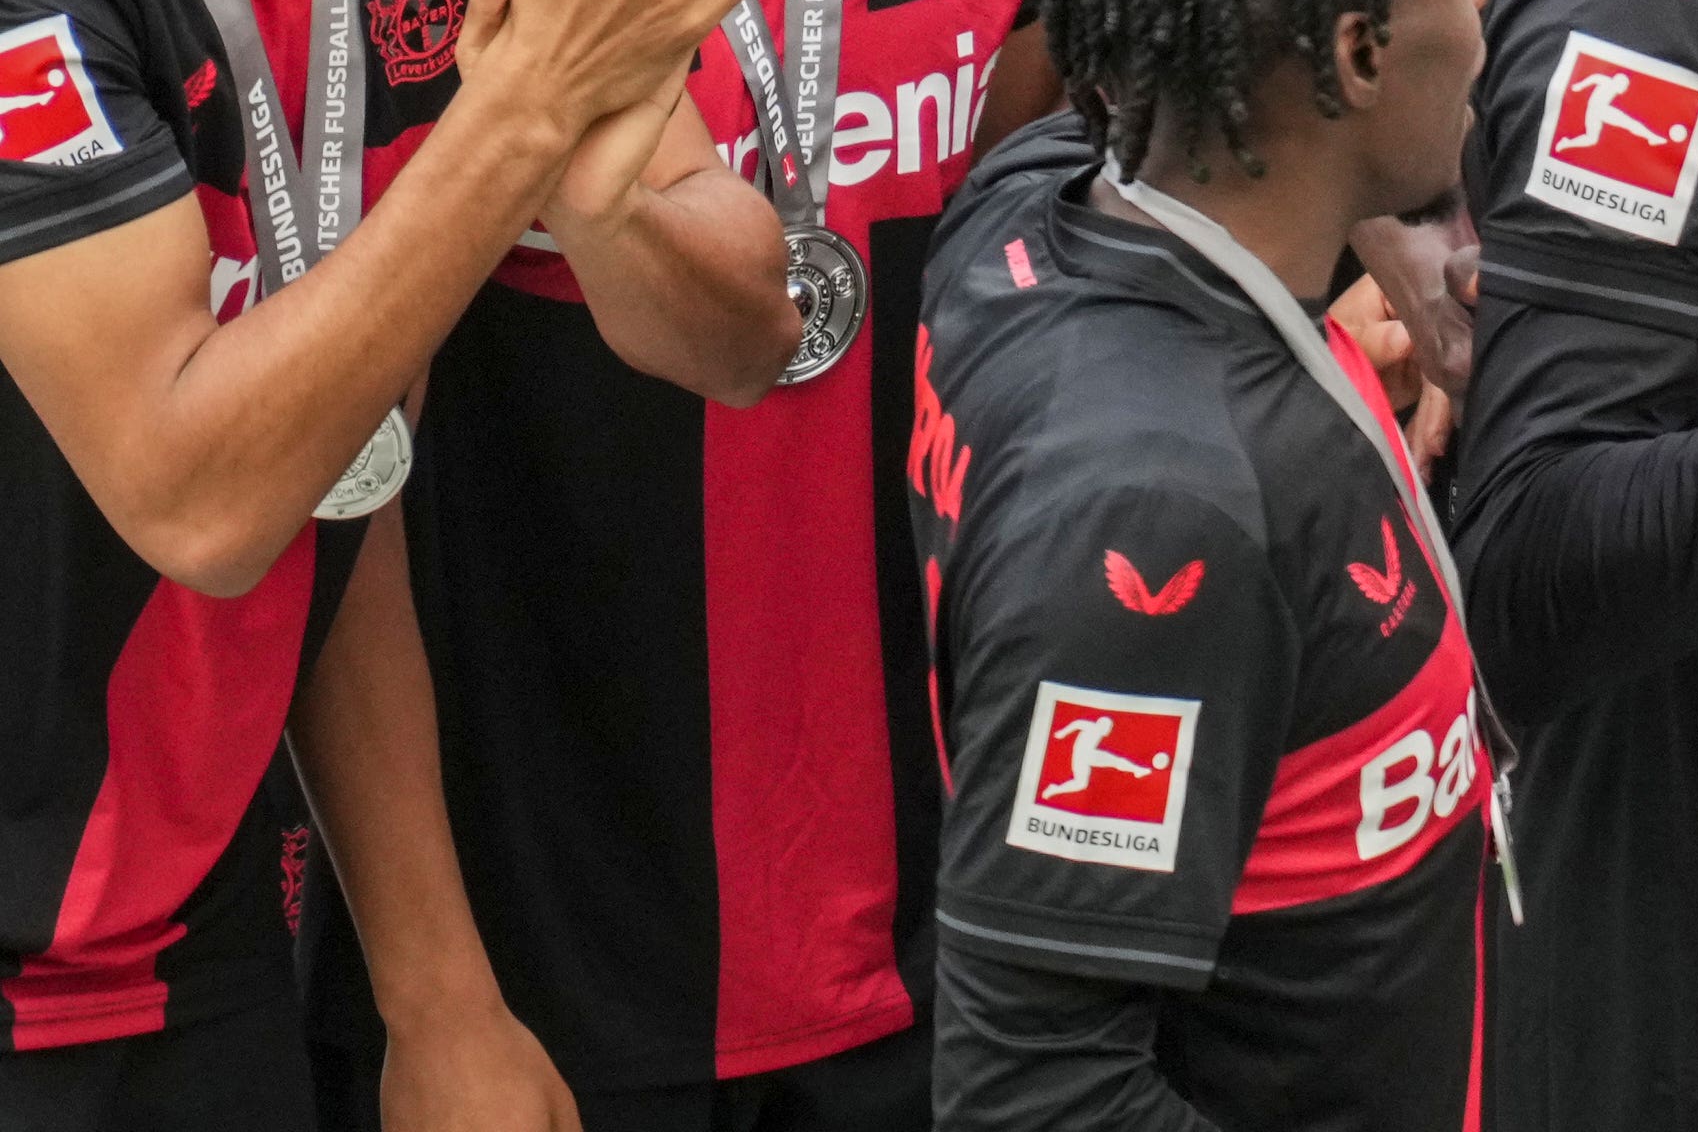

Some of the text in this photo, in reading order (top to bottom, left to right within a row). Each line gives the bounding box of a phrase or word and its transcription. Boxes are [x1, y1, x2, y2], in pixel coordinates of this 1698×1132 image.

[248, 77, 307, 285] BUNDESLIGA
[1542, 169, 1667, 226] BUNDESLIGA
[1027, 816, 1161, 853] BUNDESLIGA
